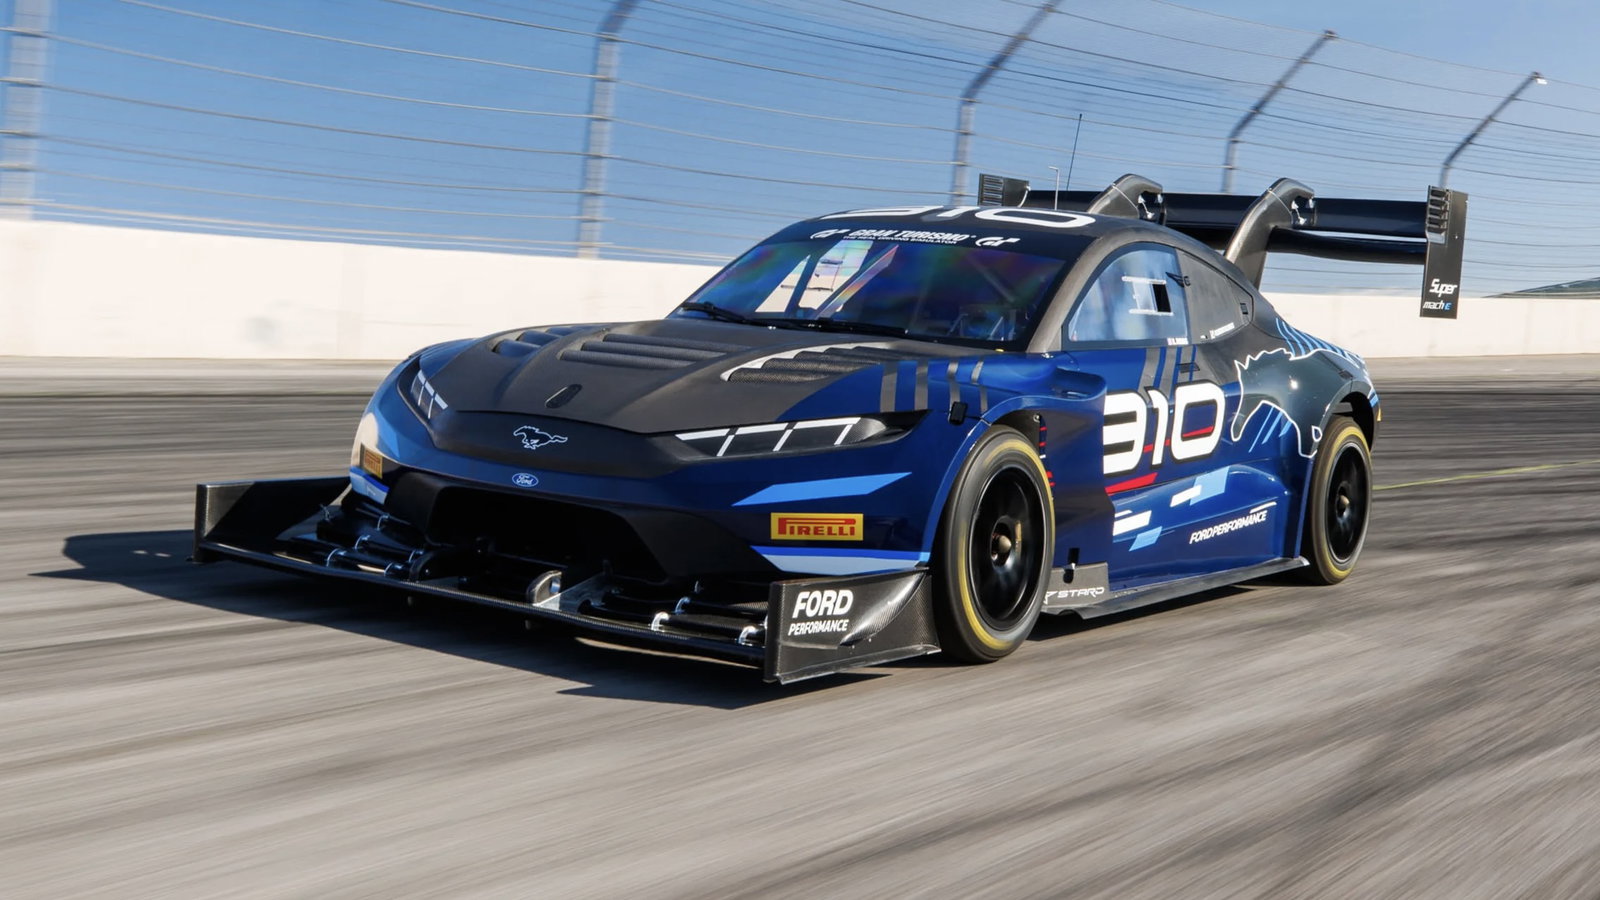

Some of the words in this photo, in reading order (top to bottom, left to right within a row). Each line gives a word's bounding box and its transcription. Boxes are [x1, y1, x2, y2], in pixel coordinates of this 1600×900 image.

[848, 229, 898, 237] GRAN
[1429, 278, 1458, 297] Super
[1103, 382, 1225, 474] 310
[778, 517, 856, 536] PIRELLI
[1057, 587, 1105, 598] STARD
[792, 590, 853, 618] FORD
[788, 619, 849, 636] PERFORMANCE
